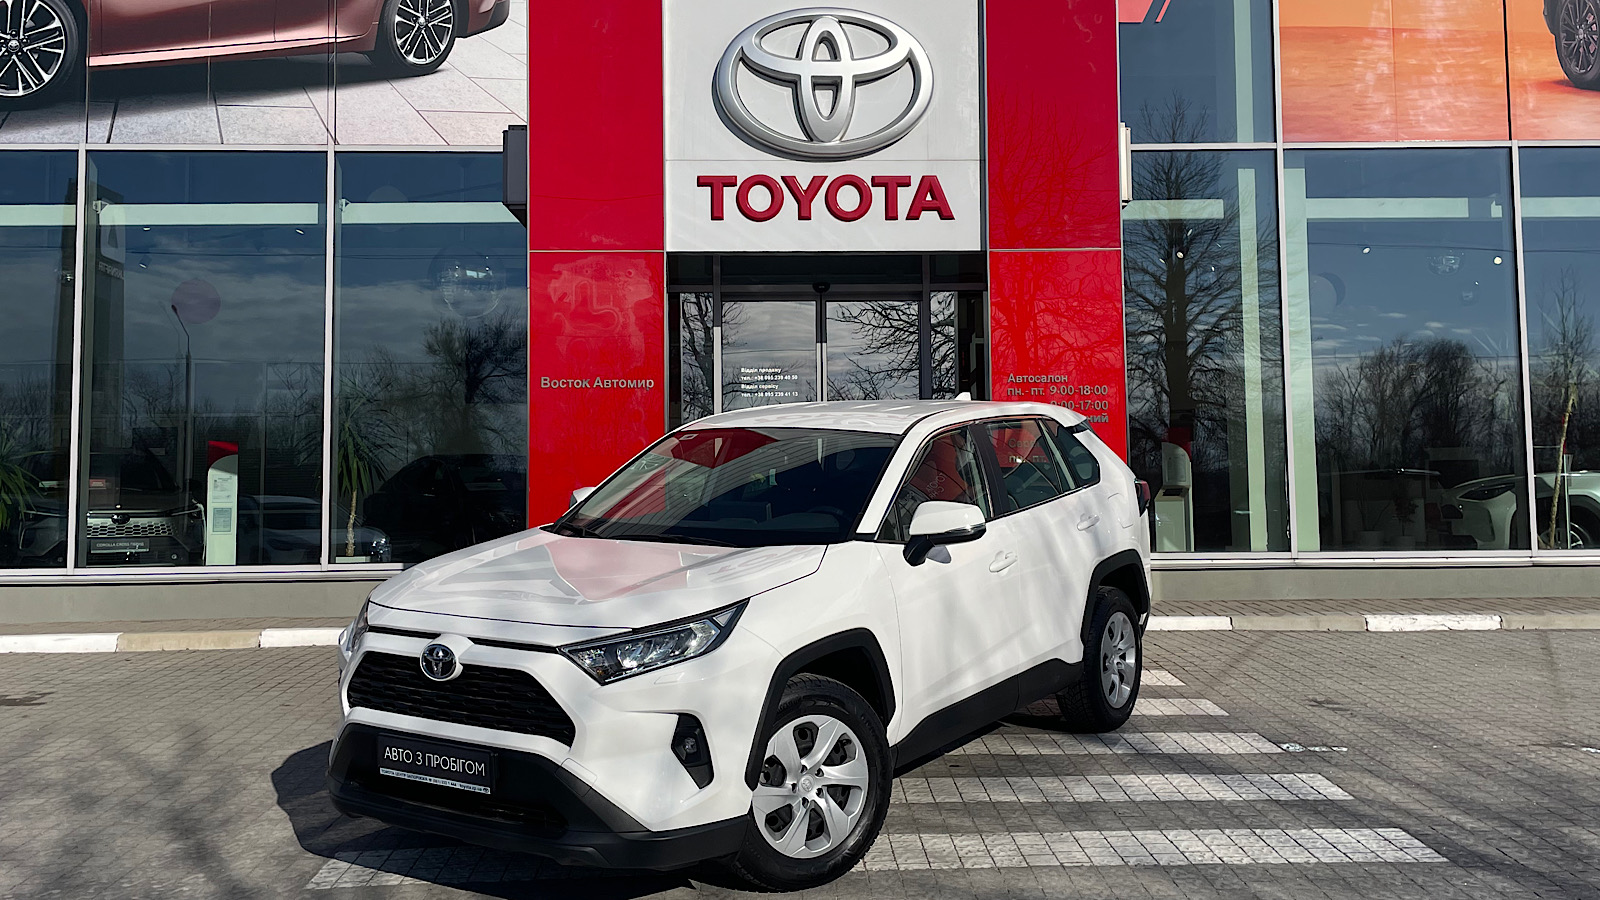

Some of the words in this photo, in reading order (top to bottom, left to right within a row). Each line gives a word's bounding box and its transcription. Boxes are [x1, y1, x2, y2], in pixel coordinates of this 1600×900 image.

[697, 173, 955, 222] TOYOTA
[540, 376, 591, 389] Восток
[593, 376, 655, 391] Автомир
[1007, 373, 1068, 384] Автосалон
[1031, 387, 1045, 396] пт.
[384, 746, 413, 764] АВТО
[425, 753, 486, 777] ПРОБІГОМ
